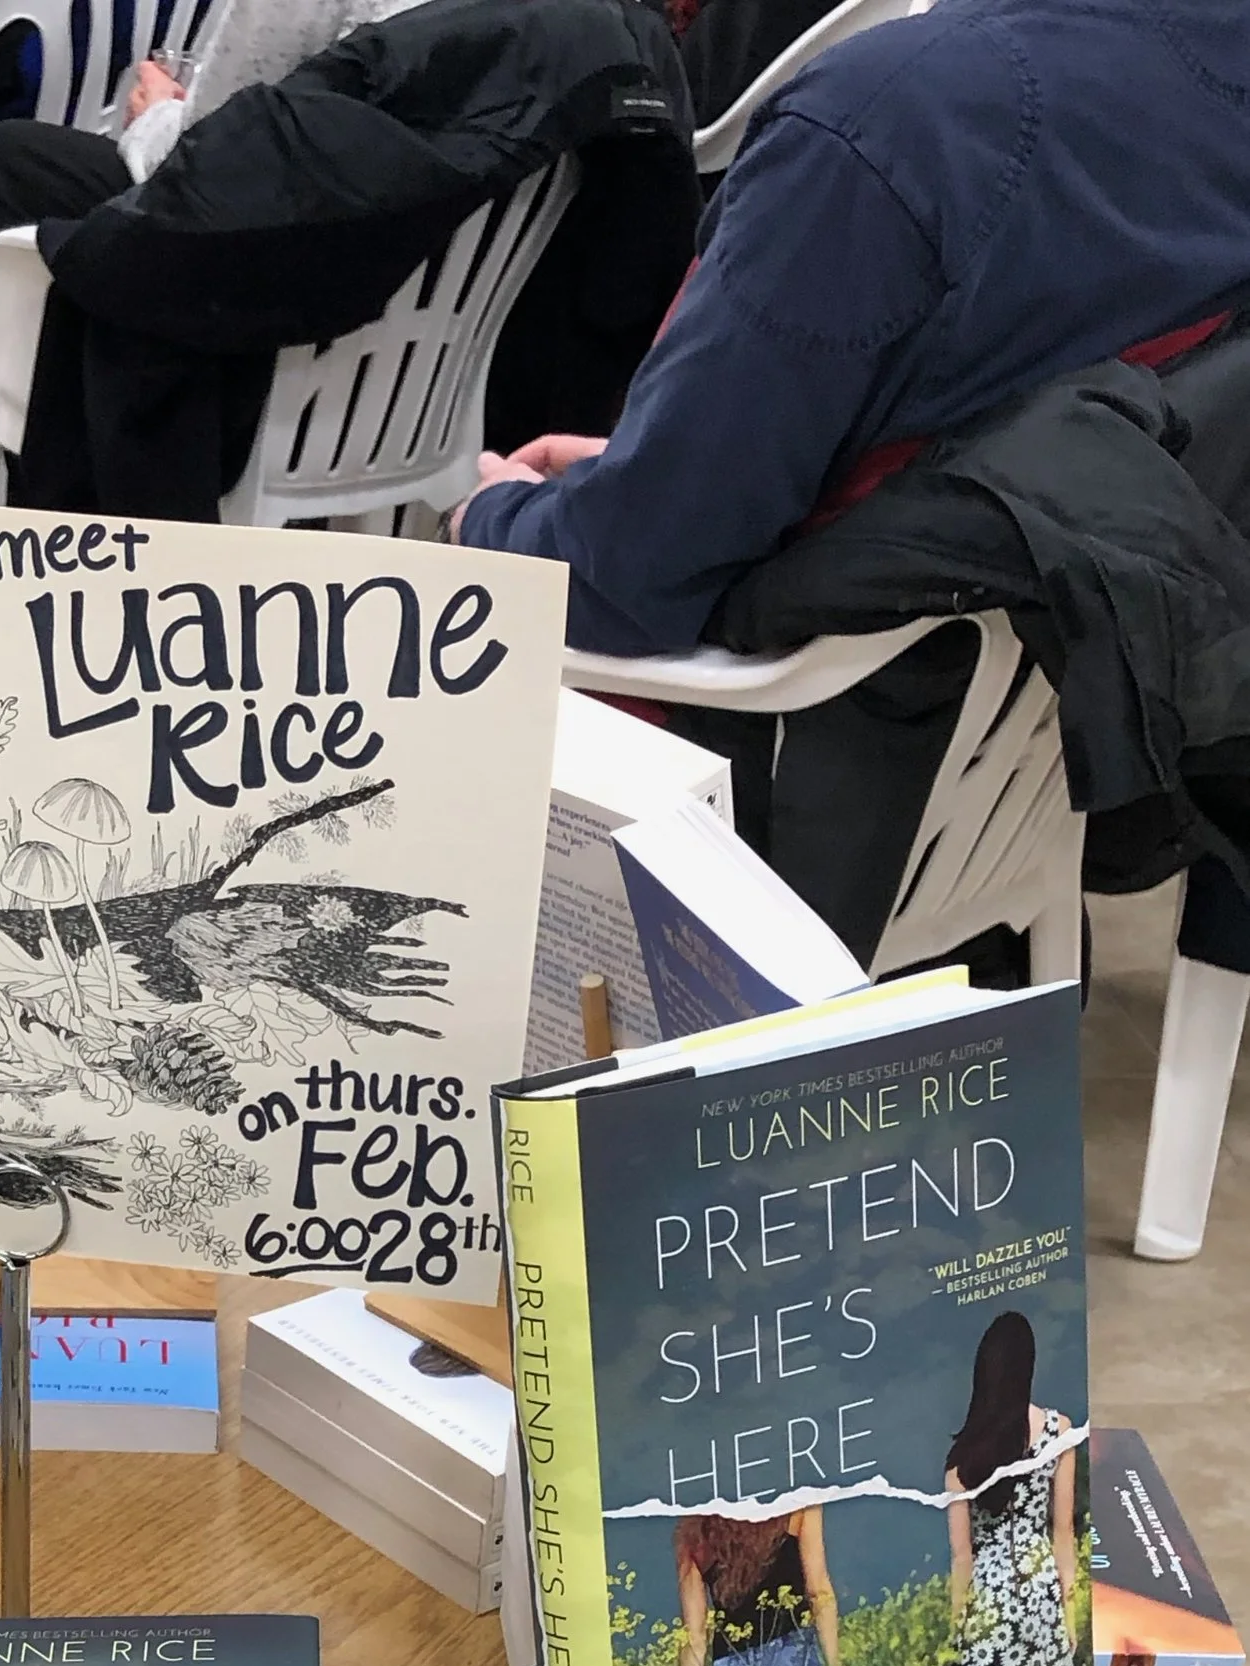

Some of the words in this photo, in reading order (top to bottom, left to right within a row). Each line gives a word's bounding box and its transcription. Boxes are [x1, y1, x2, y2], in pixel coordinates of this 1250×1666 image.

[25, 573, 510, 739] Luanne
[147, 696, 385, 814] Rice
[237, 1085, 299, 1143] on
[295, 1061, 478, 1123] thurs.
[696, 1085, 900, 1169] LUANNE
[922, 1058, 1009, 1118] RICE
[702, 1099, 743, 1118] NEW
[750, 1088, 791, 1108] YORK
[798, 1077, 843, 1097] TIMES
[848, 1051, 943, 1088] BESTSELLING
[949, 1037, 1004, 1061] AUTHOR
[295, 1119, 473, 1208] Feb.
[507, 1127, 534, 1205] RICE
[245, 1213, 368, 1266] 6:00
[367, 1211, 503, 1285] 28th
[655, 1138, 1016, 1289] PRETEND
[976, 1238, 1033, 1268] DAZZLE
[946, 1262, 1022, 1294] BESTSELLING
[1025, 1246, 1069, 1270] AUTHOR
[957, 1284, 1004, 1306] HARLAN
[1008, 1270, 1047, 1290] COBEN
[515, 1260, 555, 1466] PRETEND
[659, 1288, 878, 1403] SHE'S
[667, 1398, 878, 1506] HERE
[532, 1484, 566, 1597] SHE'S
[33, 1629, 138, 1640] BESTSELLING
[145, 1628, 212, 1638] AUTHOR
[111, 1639, 216, 1662] RICE
